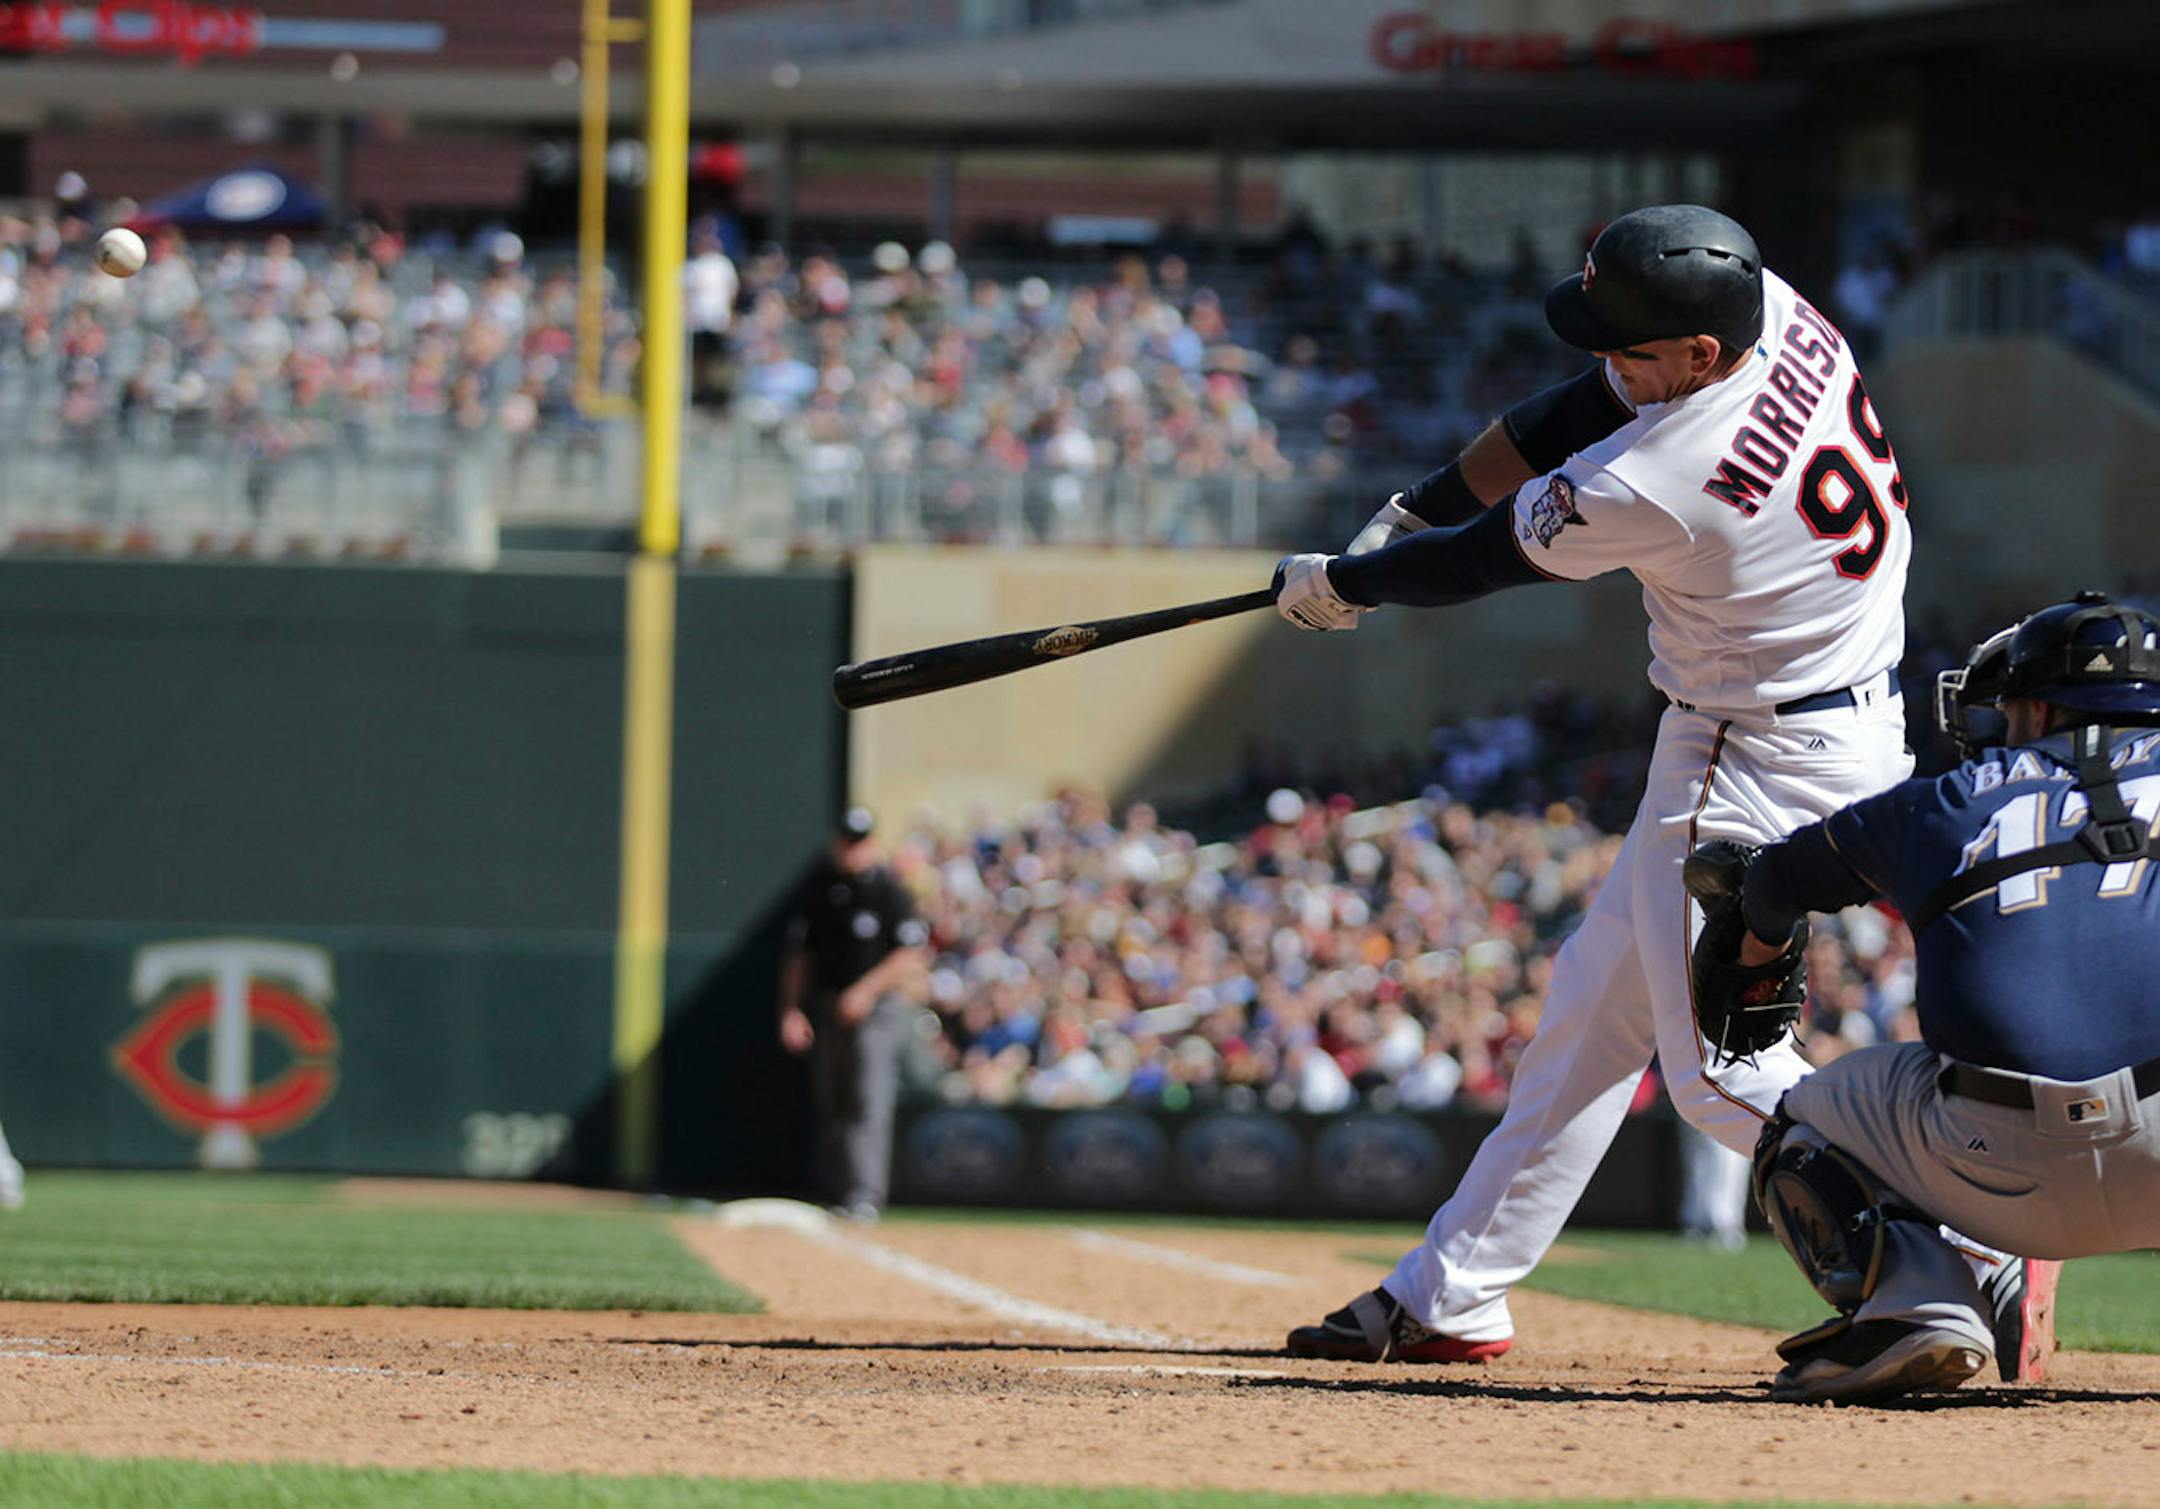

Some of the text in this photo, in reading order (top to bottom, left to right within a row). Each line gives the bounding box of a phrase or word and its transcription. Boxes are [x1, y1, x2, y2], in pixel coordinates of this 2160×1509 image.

[1703, 290, 1843, 518] MORRISO
[1795, 372, 1908, 581] 99
[1972, 732, 2160, 797] BAY
